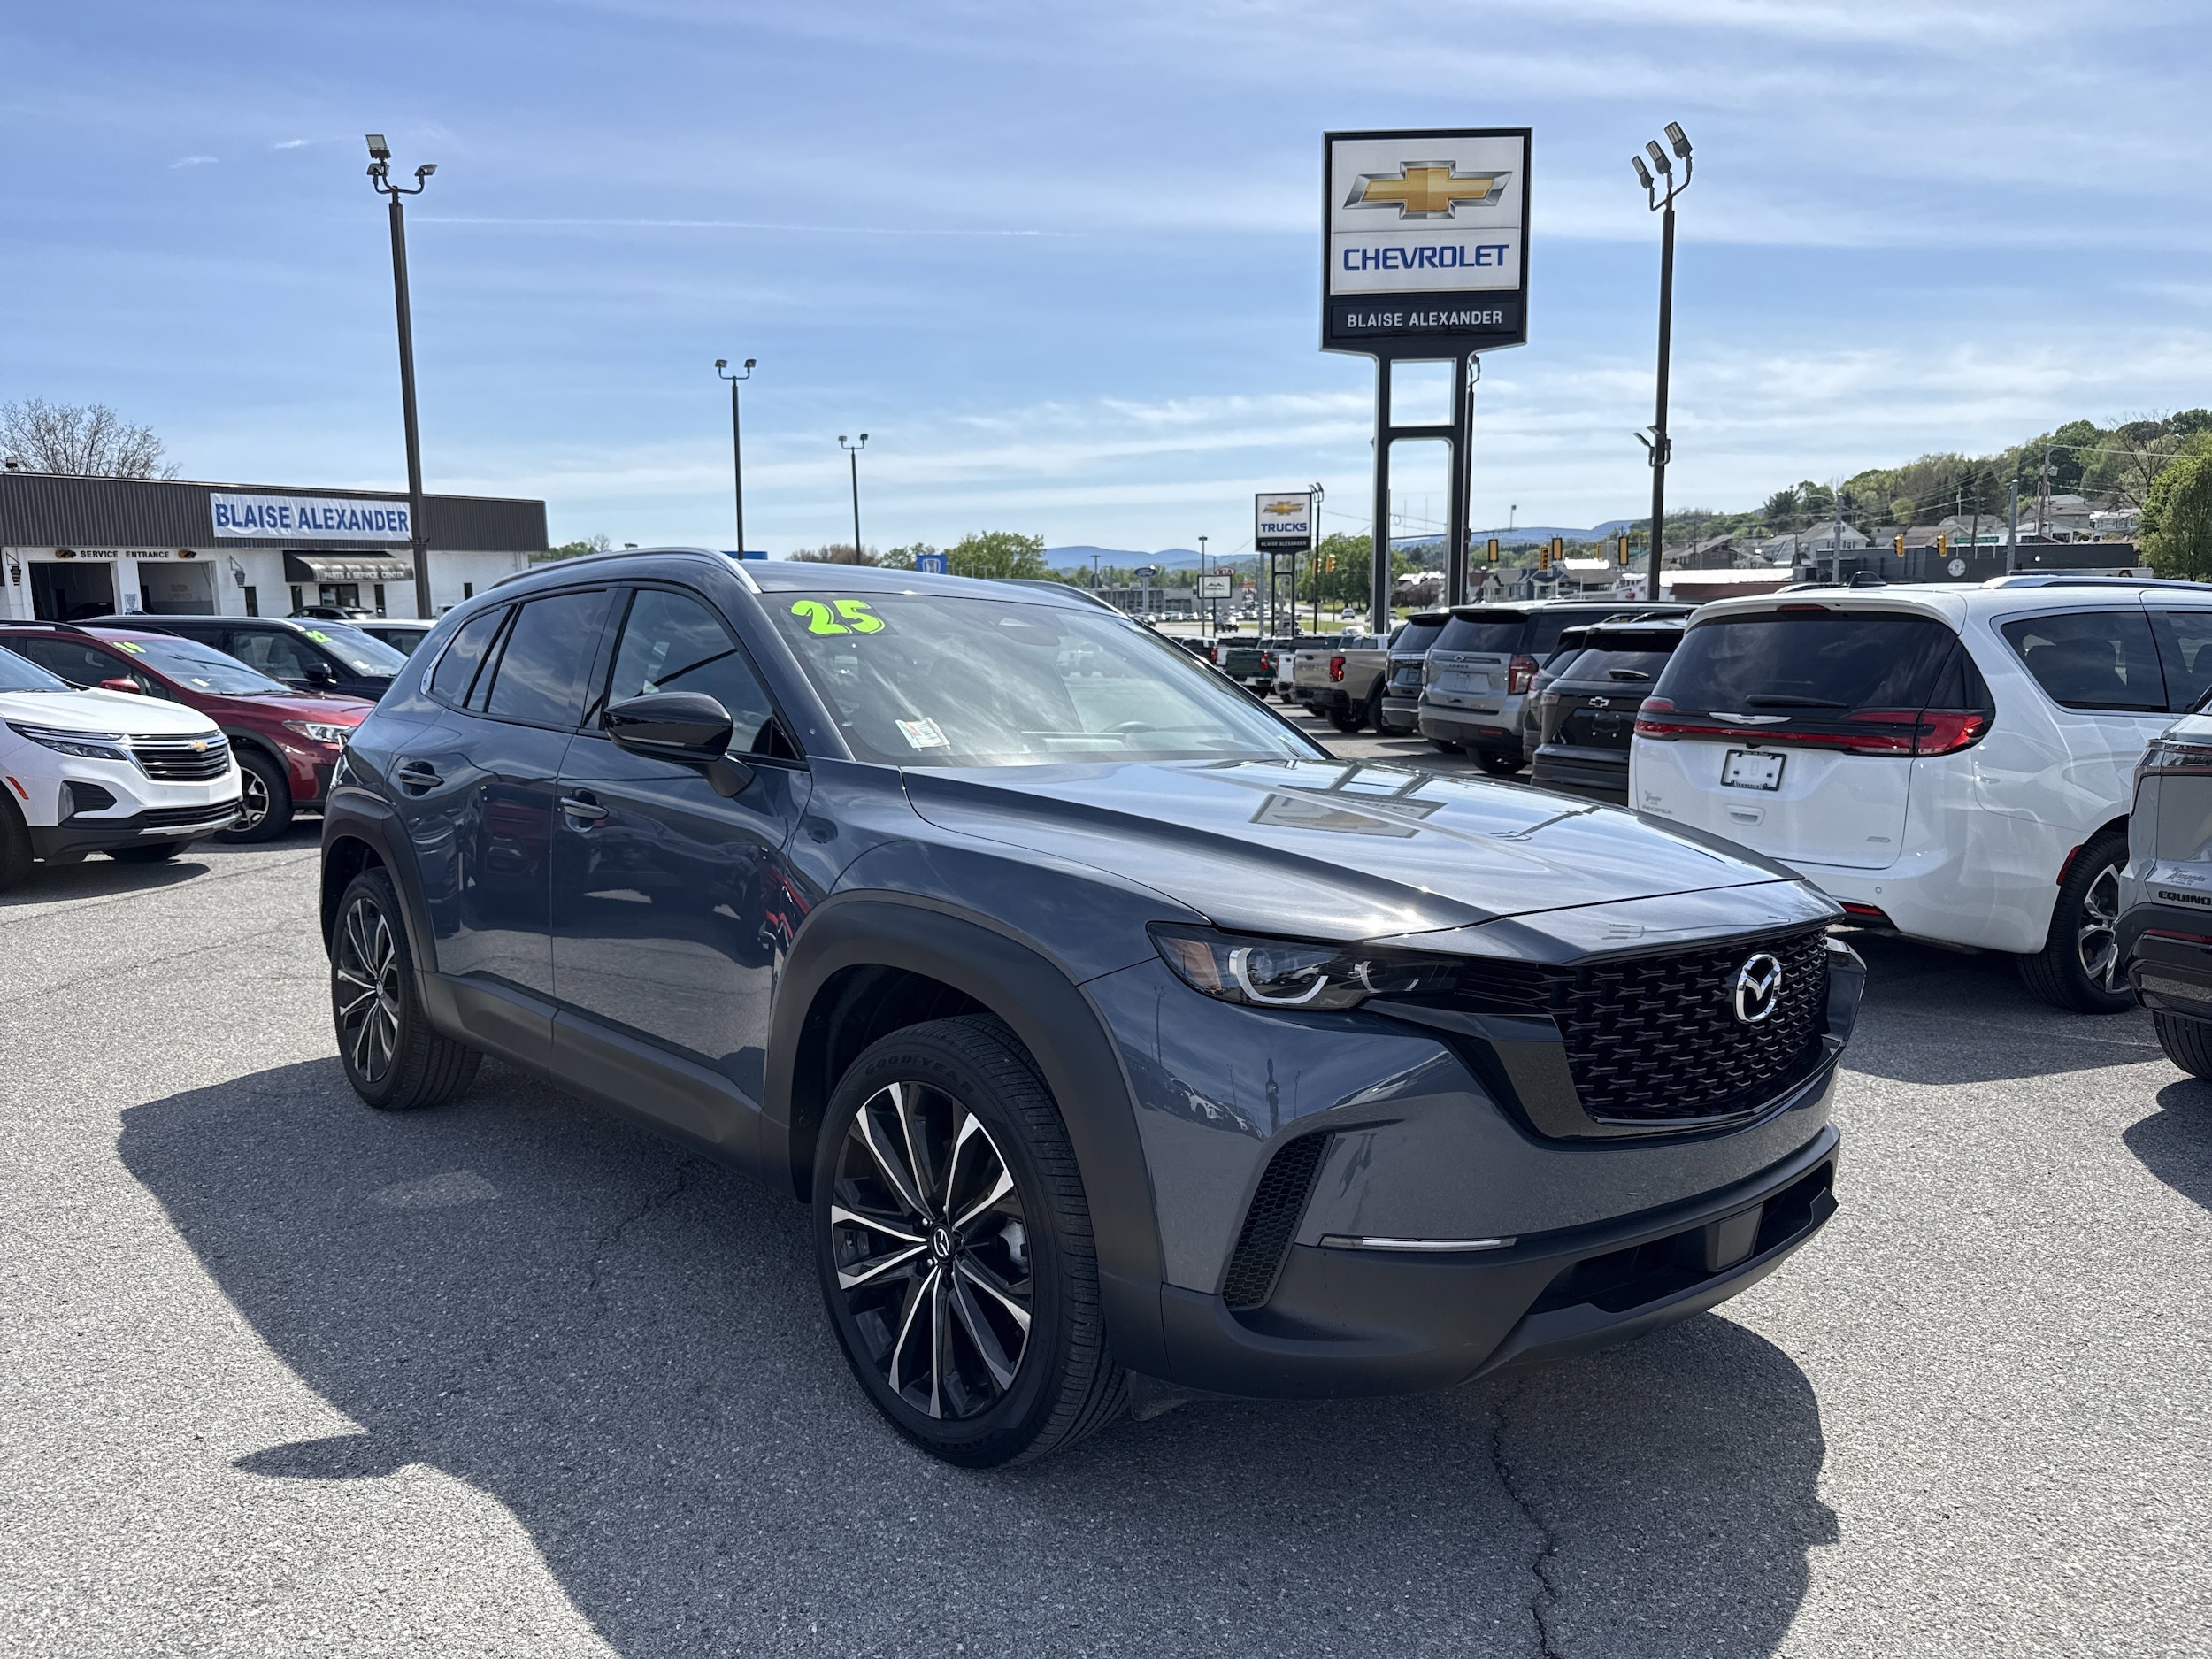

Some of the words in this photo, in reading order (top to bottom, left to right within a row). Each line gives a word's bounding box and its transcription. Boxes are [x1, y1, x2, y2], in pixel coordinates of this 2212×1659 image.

[1343, 244, 1509, 271] CHEVROLET
[1347, 312, 1403, 328] BLAISE
[1409, 311, 1502, 326] ALEXANDER
[215, 503, 292, 528] BLAISE
[298, 507, 410, 532] ALEXANDER
[1260, 523, 1307, 533] TRUCKS
[790, 599, 885, 635] 25
[2158, 890, 2212, 905] EQUINO
[865, 1055, 974, 1094] GOODYEAR
